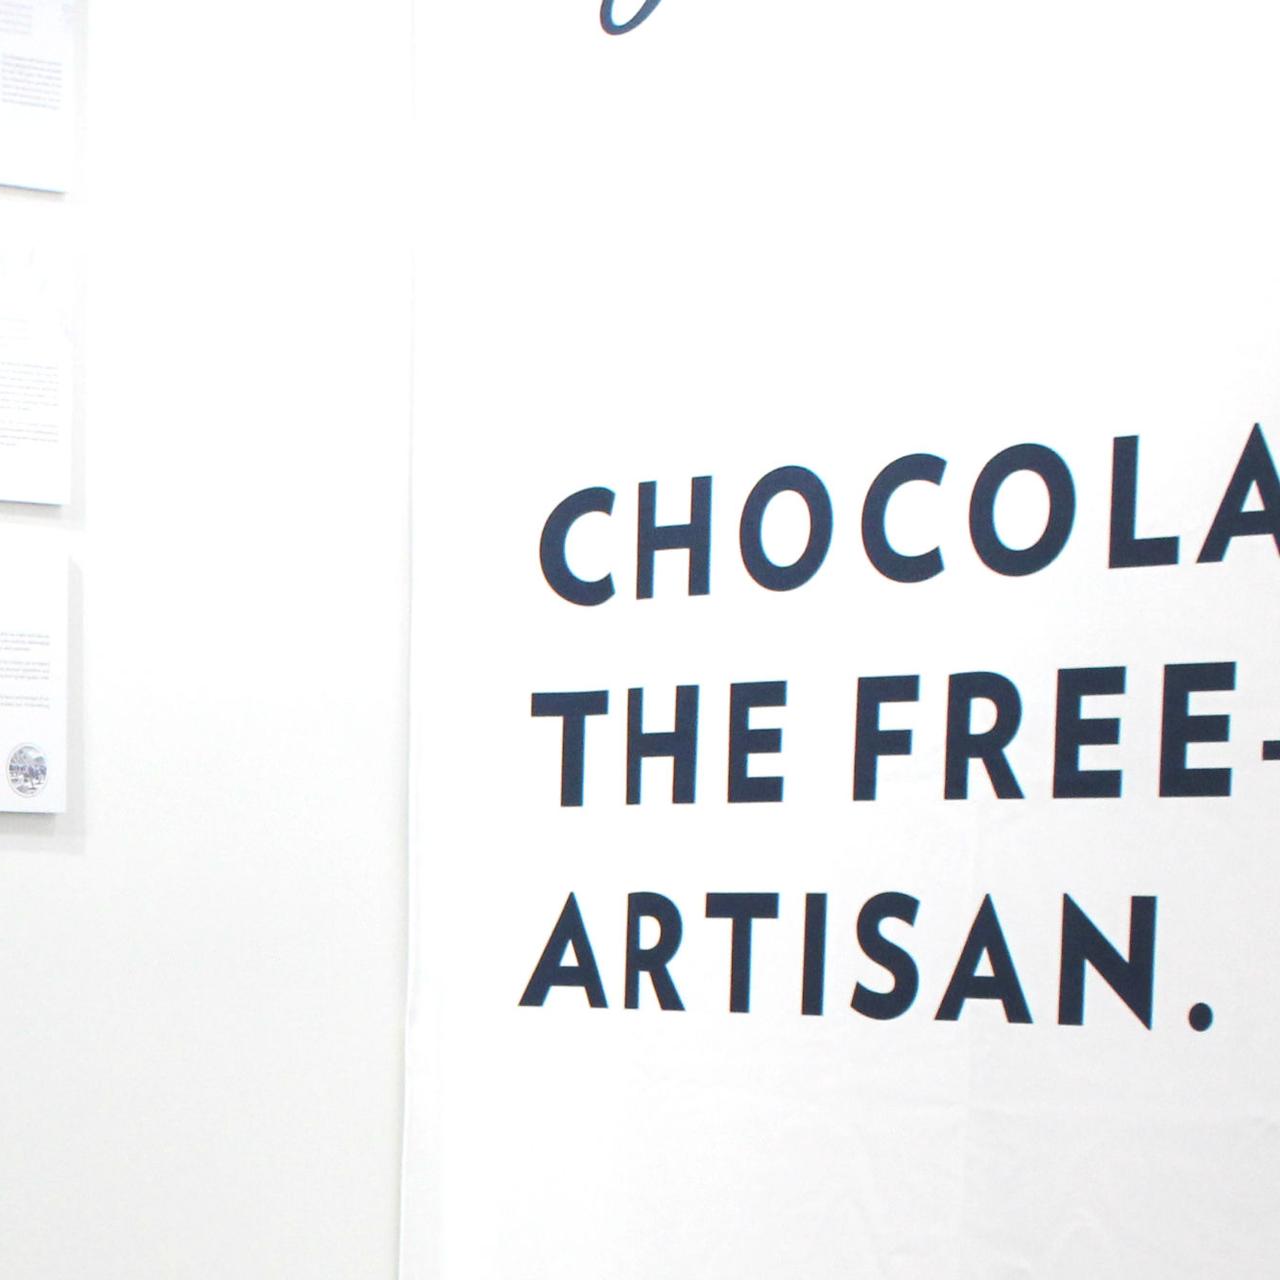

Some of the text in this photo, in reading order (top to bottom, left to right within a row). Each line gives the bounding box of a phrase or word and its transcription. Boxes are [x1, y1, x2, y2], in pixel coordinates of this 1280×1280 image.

[539, 423, 1280, 606] CHOCOLA
[530, 661, 1280, 807] THE FREE-
[519, 892, 1213, 1031] ARTISAN.
